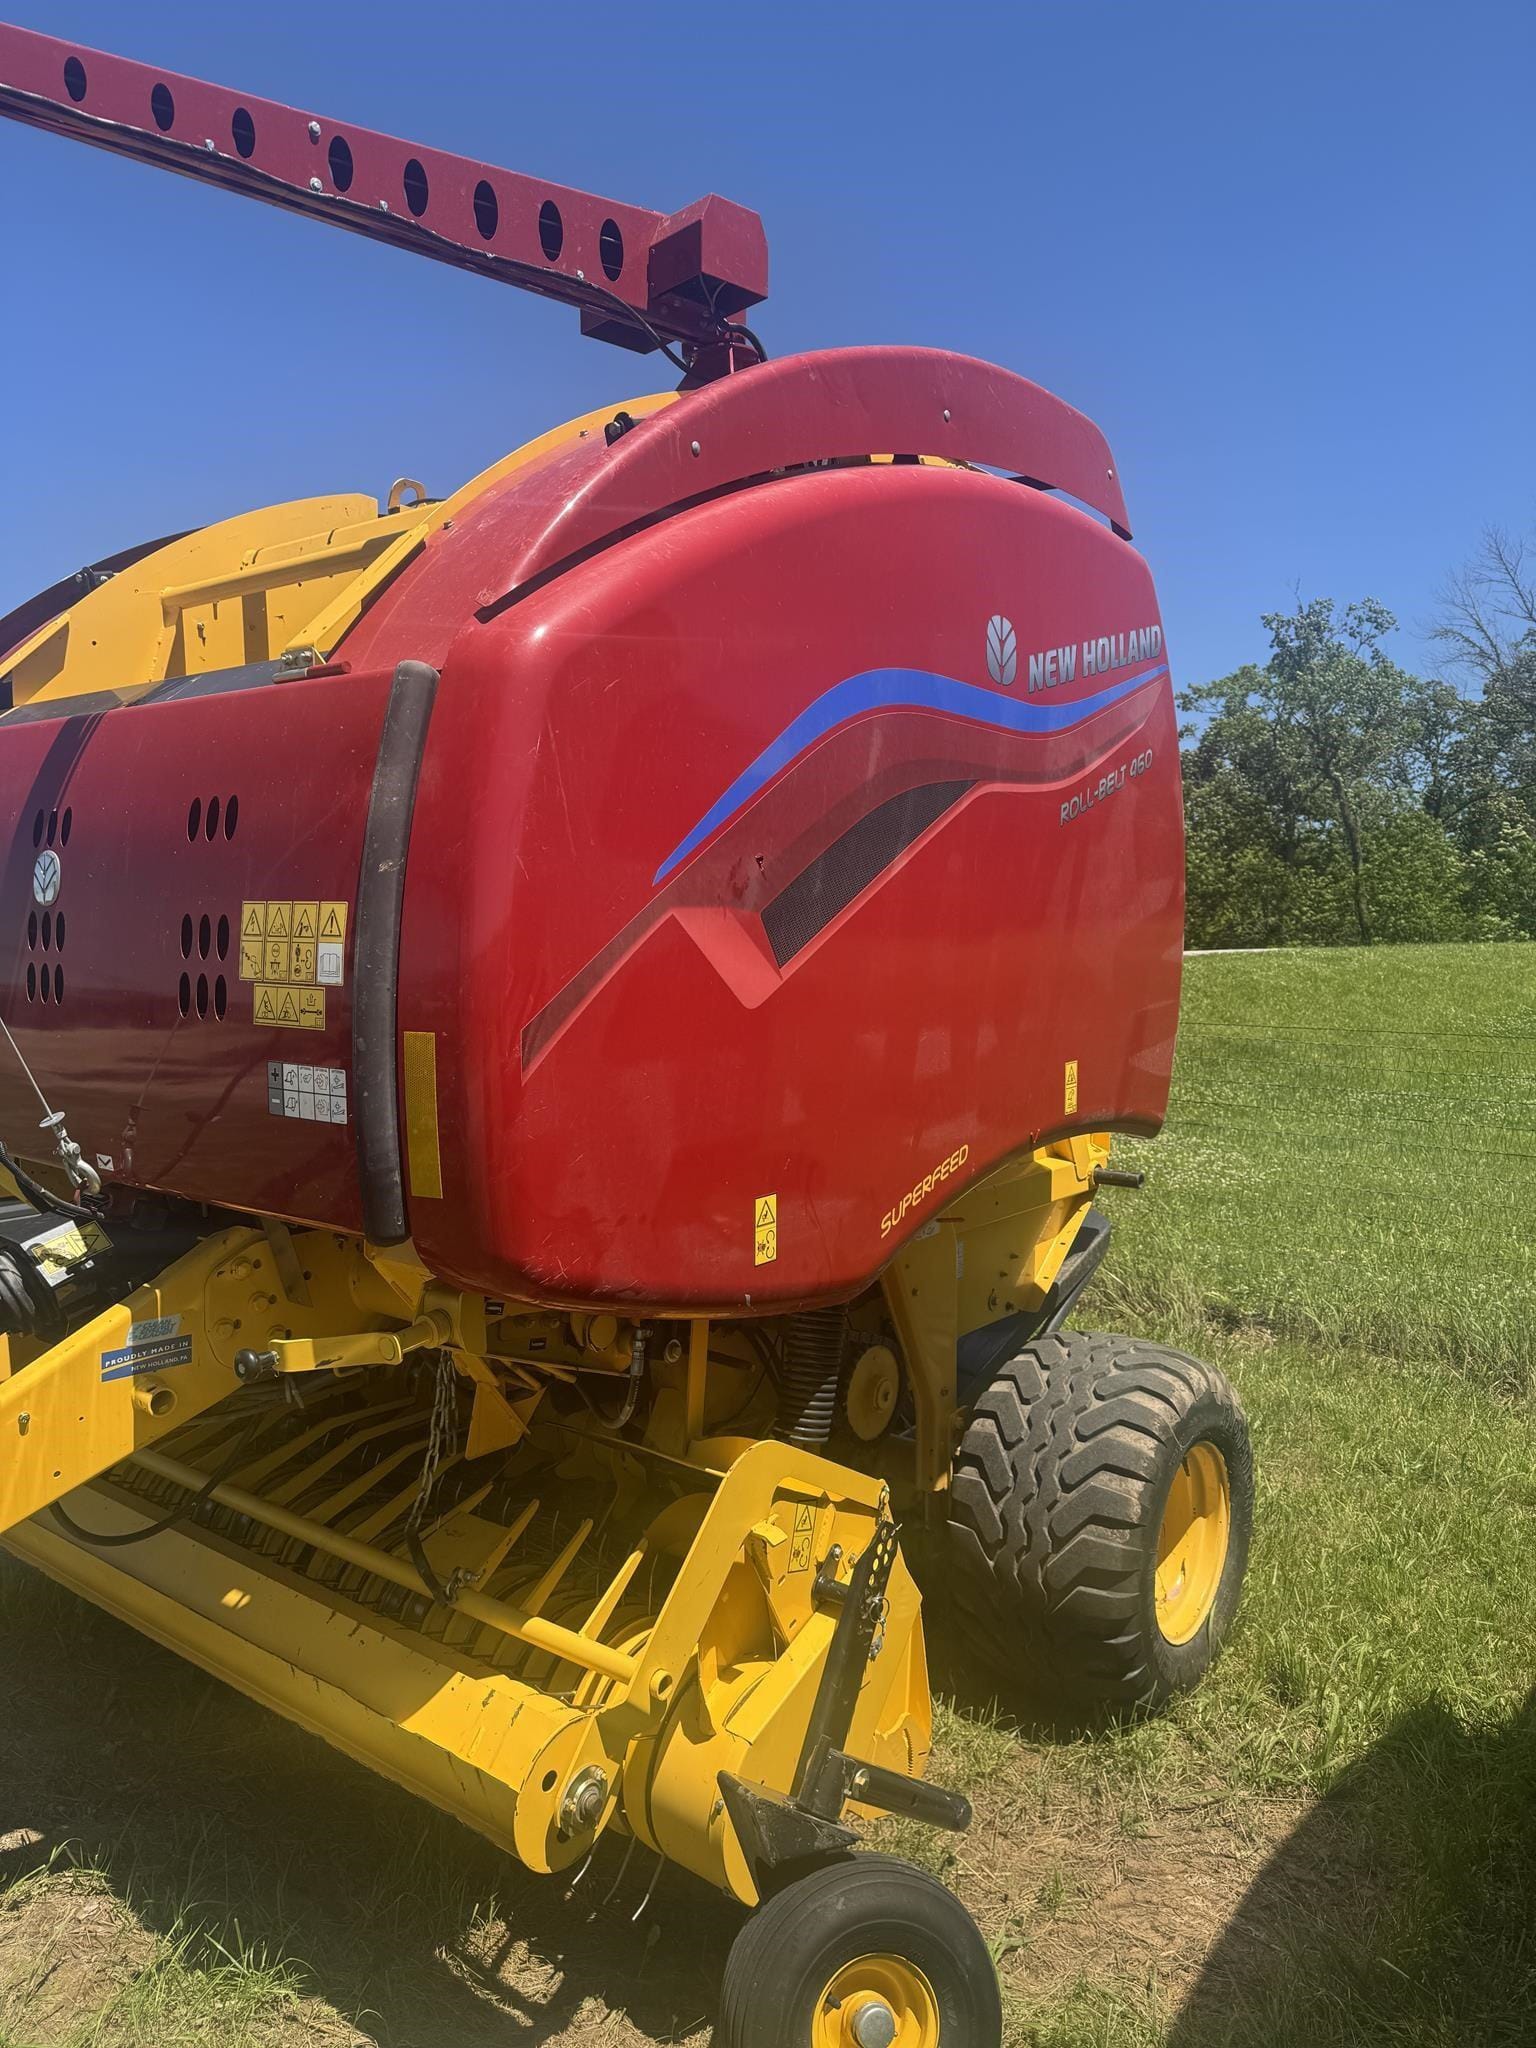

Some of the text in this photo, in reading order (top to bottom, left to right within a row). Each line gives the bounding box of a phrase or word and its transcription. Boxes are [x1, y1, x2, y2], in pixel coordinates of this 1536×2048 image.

[1028, 625, 1161, 694] NEW HOLLAND
[1060, 765, 1126, 826] ROLL-BELT
[880, 1144, 969, 1239] SUPERFEED
[105, 1340, 189, 1367] PROUDLY MADE IN
[131, 1364, 146, 1372] NEW
